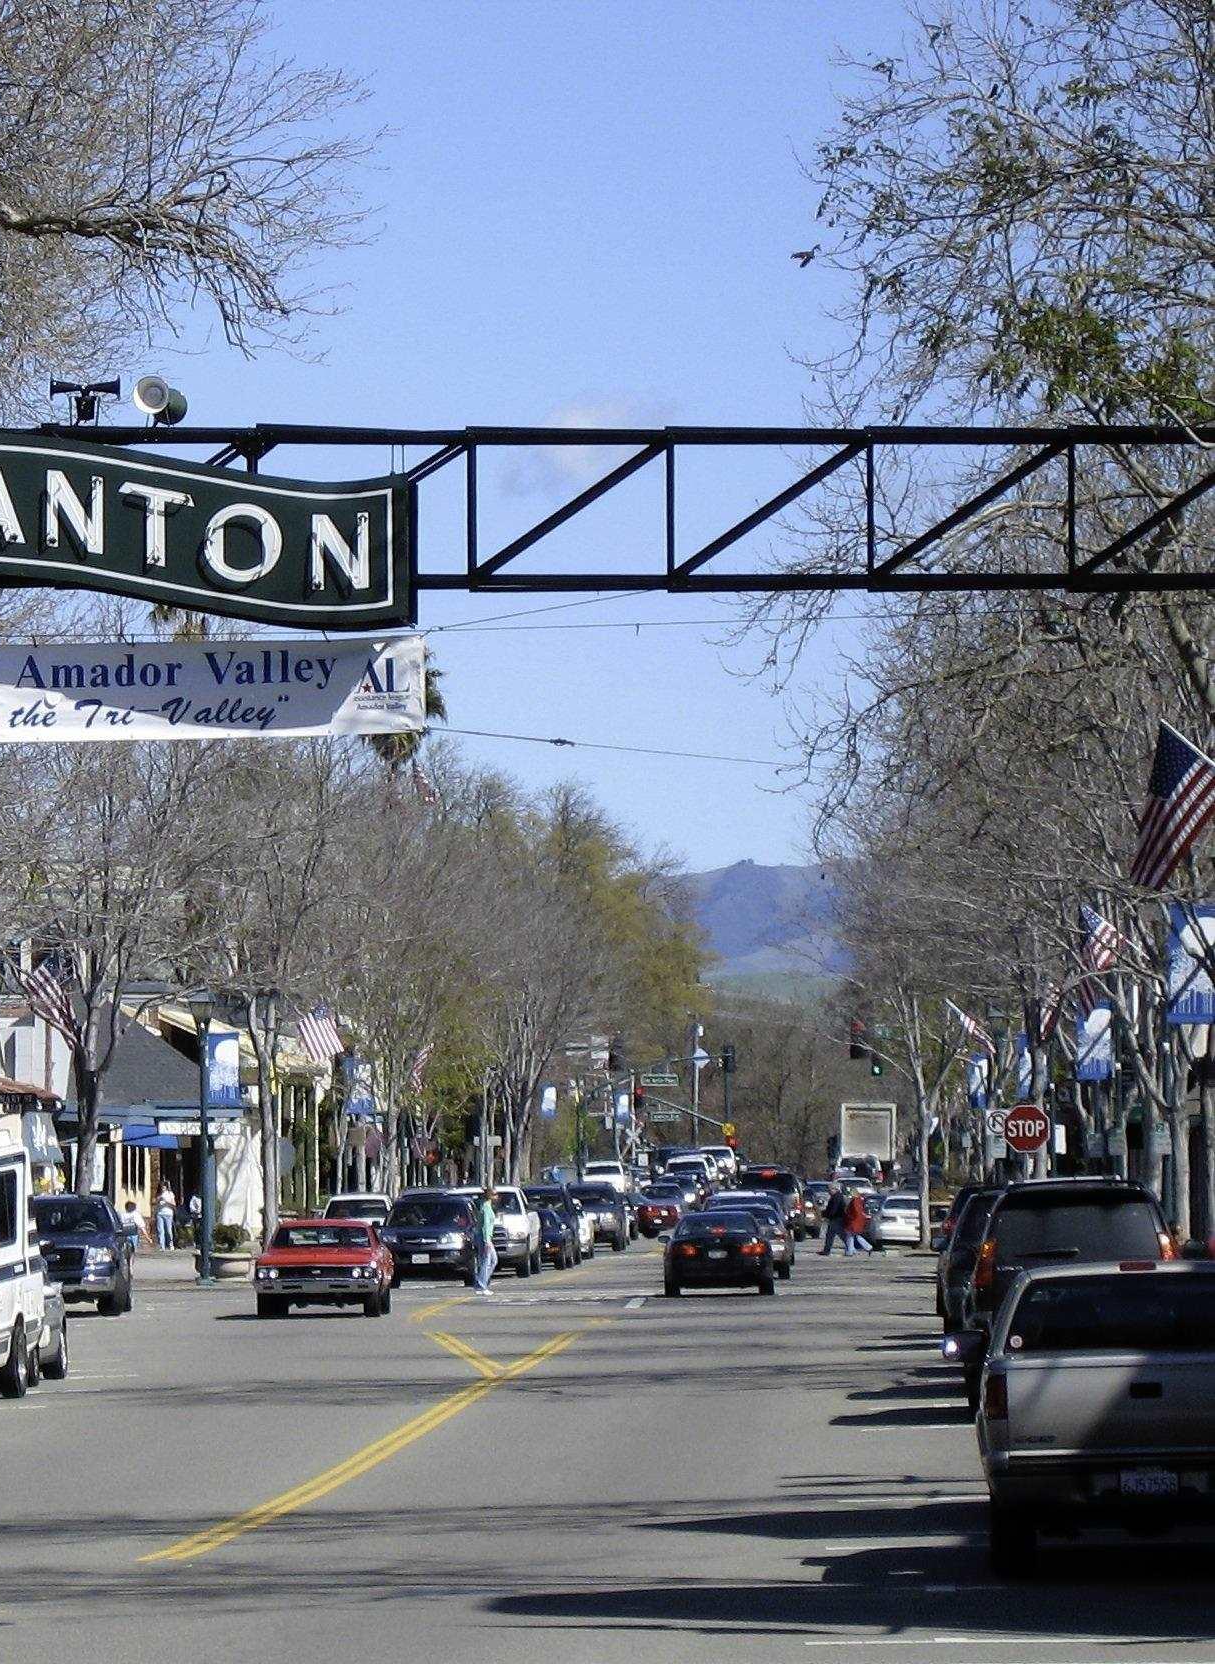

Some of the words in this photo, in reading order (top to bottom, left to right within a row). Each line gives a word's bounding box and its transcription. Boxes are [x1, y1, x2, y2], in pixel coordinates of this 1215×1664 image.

[15, 653, 183, 690] Amador
[203, 650, 338, 690] Valley
[354, 657, 411, 692] AL
[8, 699, 58, 728] the
[1007, 1120, 1045, 1138] STOP
